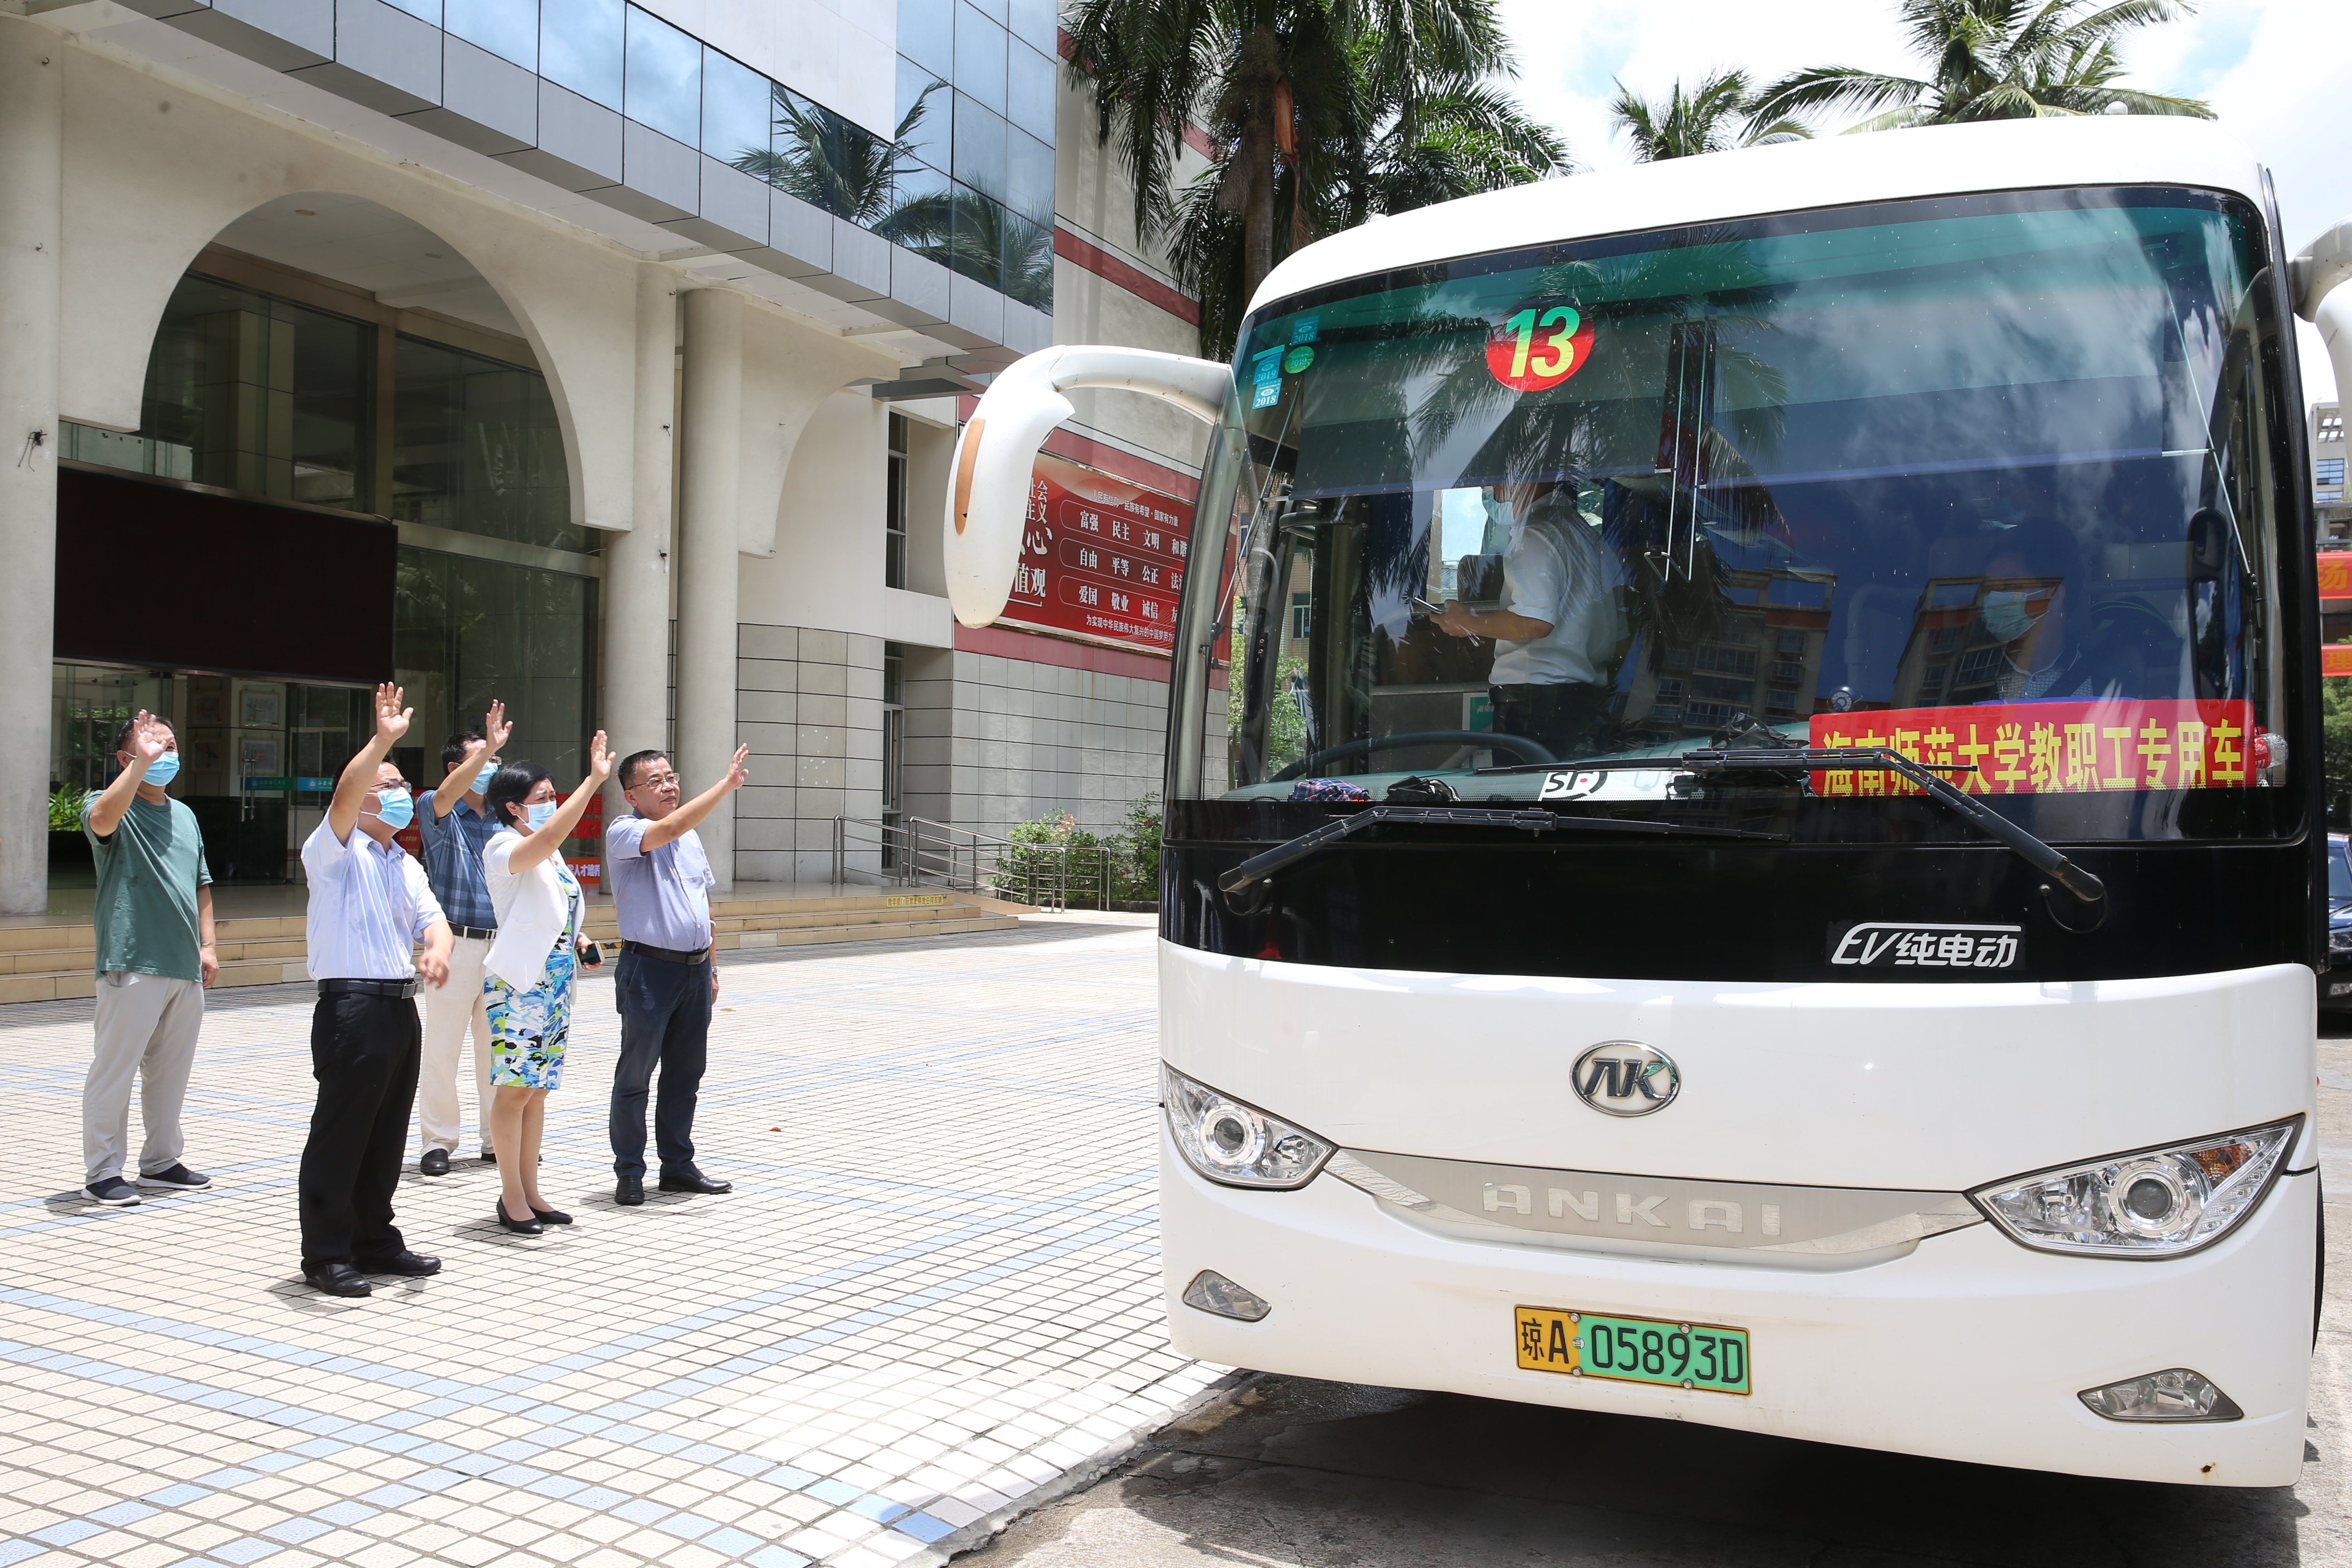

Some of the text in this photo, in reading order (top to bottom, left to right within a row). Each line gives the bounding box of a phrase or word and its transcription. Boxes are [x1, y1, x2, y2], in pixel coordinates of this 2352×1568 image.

[1293, 332, 1315, 343] 2018
[1505, 306, 1581, 377] 13
[1256, 370, 1276, 382] 2019
[1290, 358, 1307, 368] 2019
[1255, 395, 1276, 407] 2018
[1020, 527, 1053, 555] 心
[1079, 510, 1187, 558] 富强 民主 文明 和谐
[1079, 548, 1098, 569] 自由
[1112, 557, 1129, 577] 平等
[1142, 565, 1159, 584] 公正
[1079, 585, 1098, 606] 爱国
[1112, 592, 1129, 612] 敬业
[1142, 599, 1159, 619] 诚信
[1482, 1182, 1782, 1236] ANKAI
[1591, 1324, 1744, 1384] 05893D
